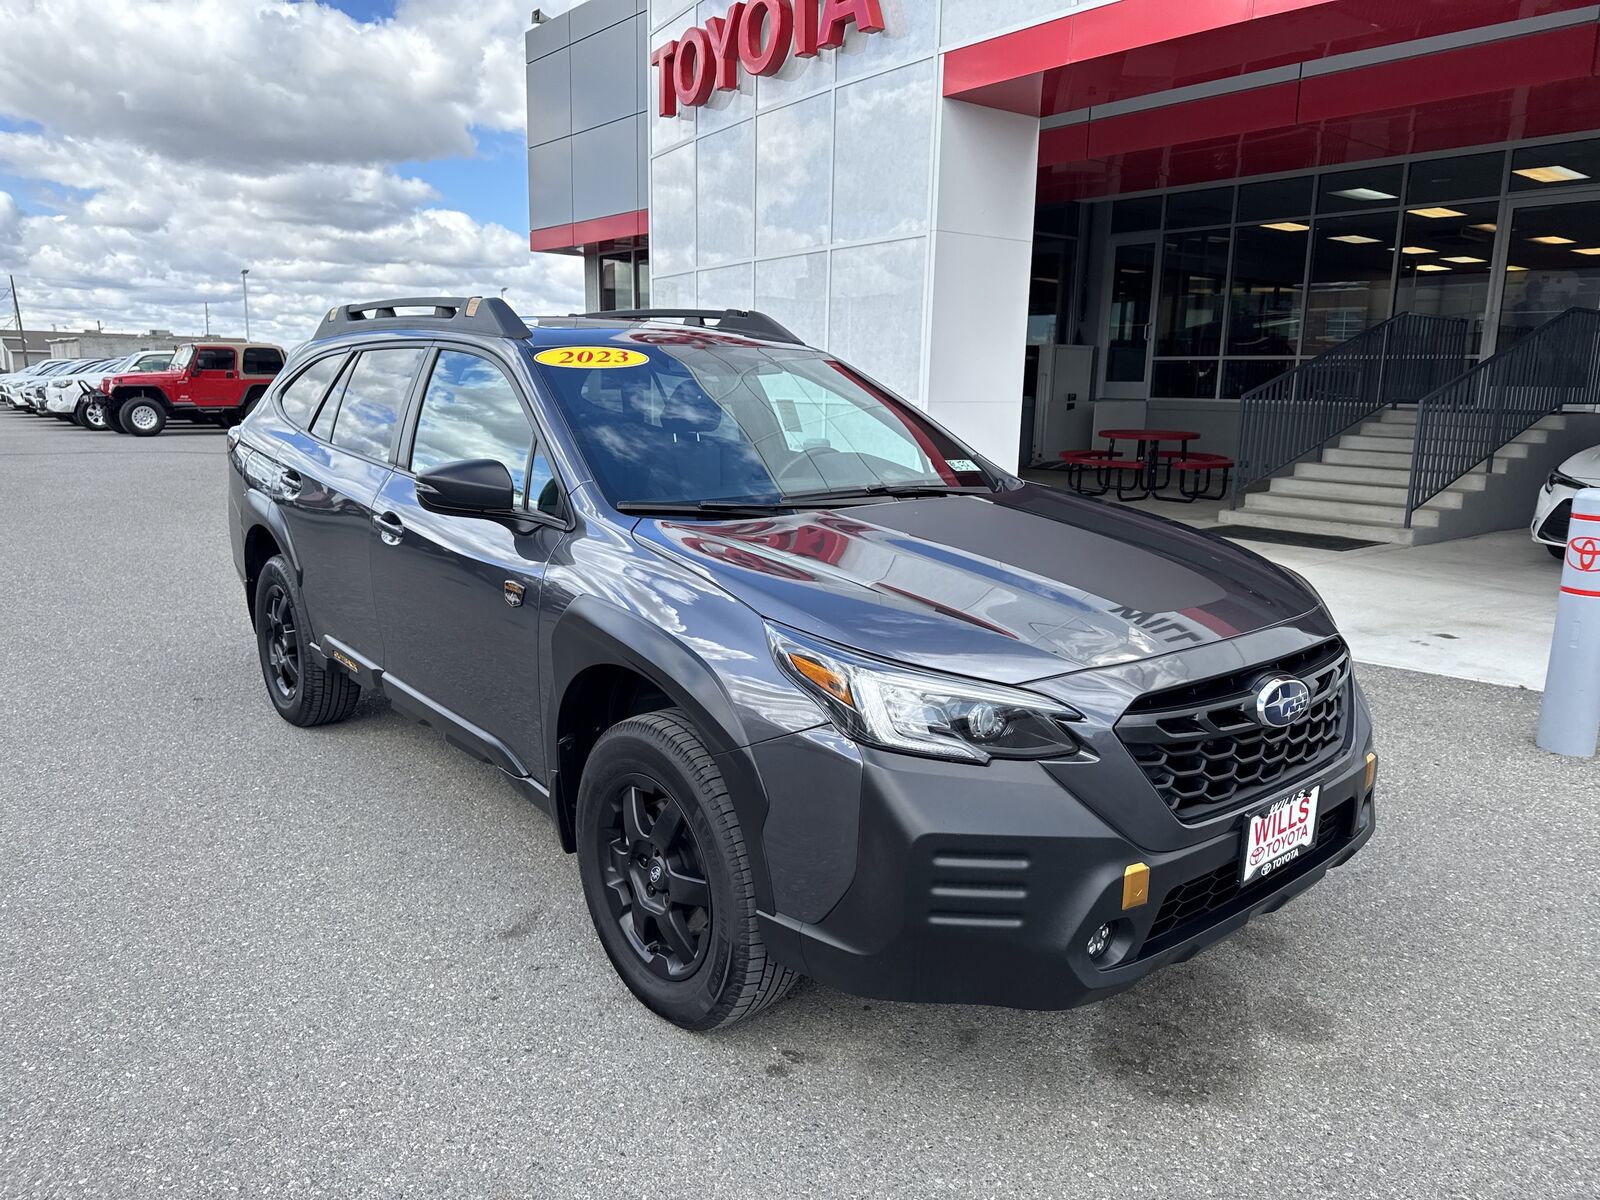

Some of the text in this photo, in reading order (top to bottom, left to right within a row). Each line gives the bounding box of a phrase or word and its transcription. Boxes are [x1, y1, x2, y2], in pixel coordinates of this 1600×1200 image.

[558, 350, 629, 364] 2023
[1269, 788, 1306, 814] WILLS
[1255, 796, 1310, 846] WILLS
[1266, 823, 1308, 857] TOYOTA
[1272, 848, 1299, 869] TOYOTA
